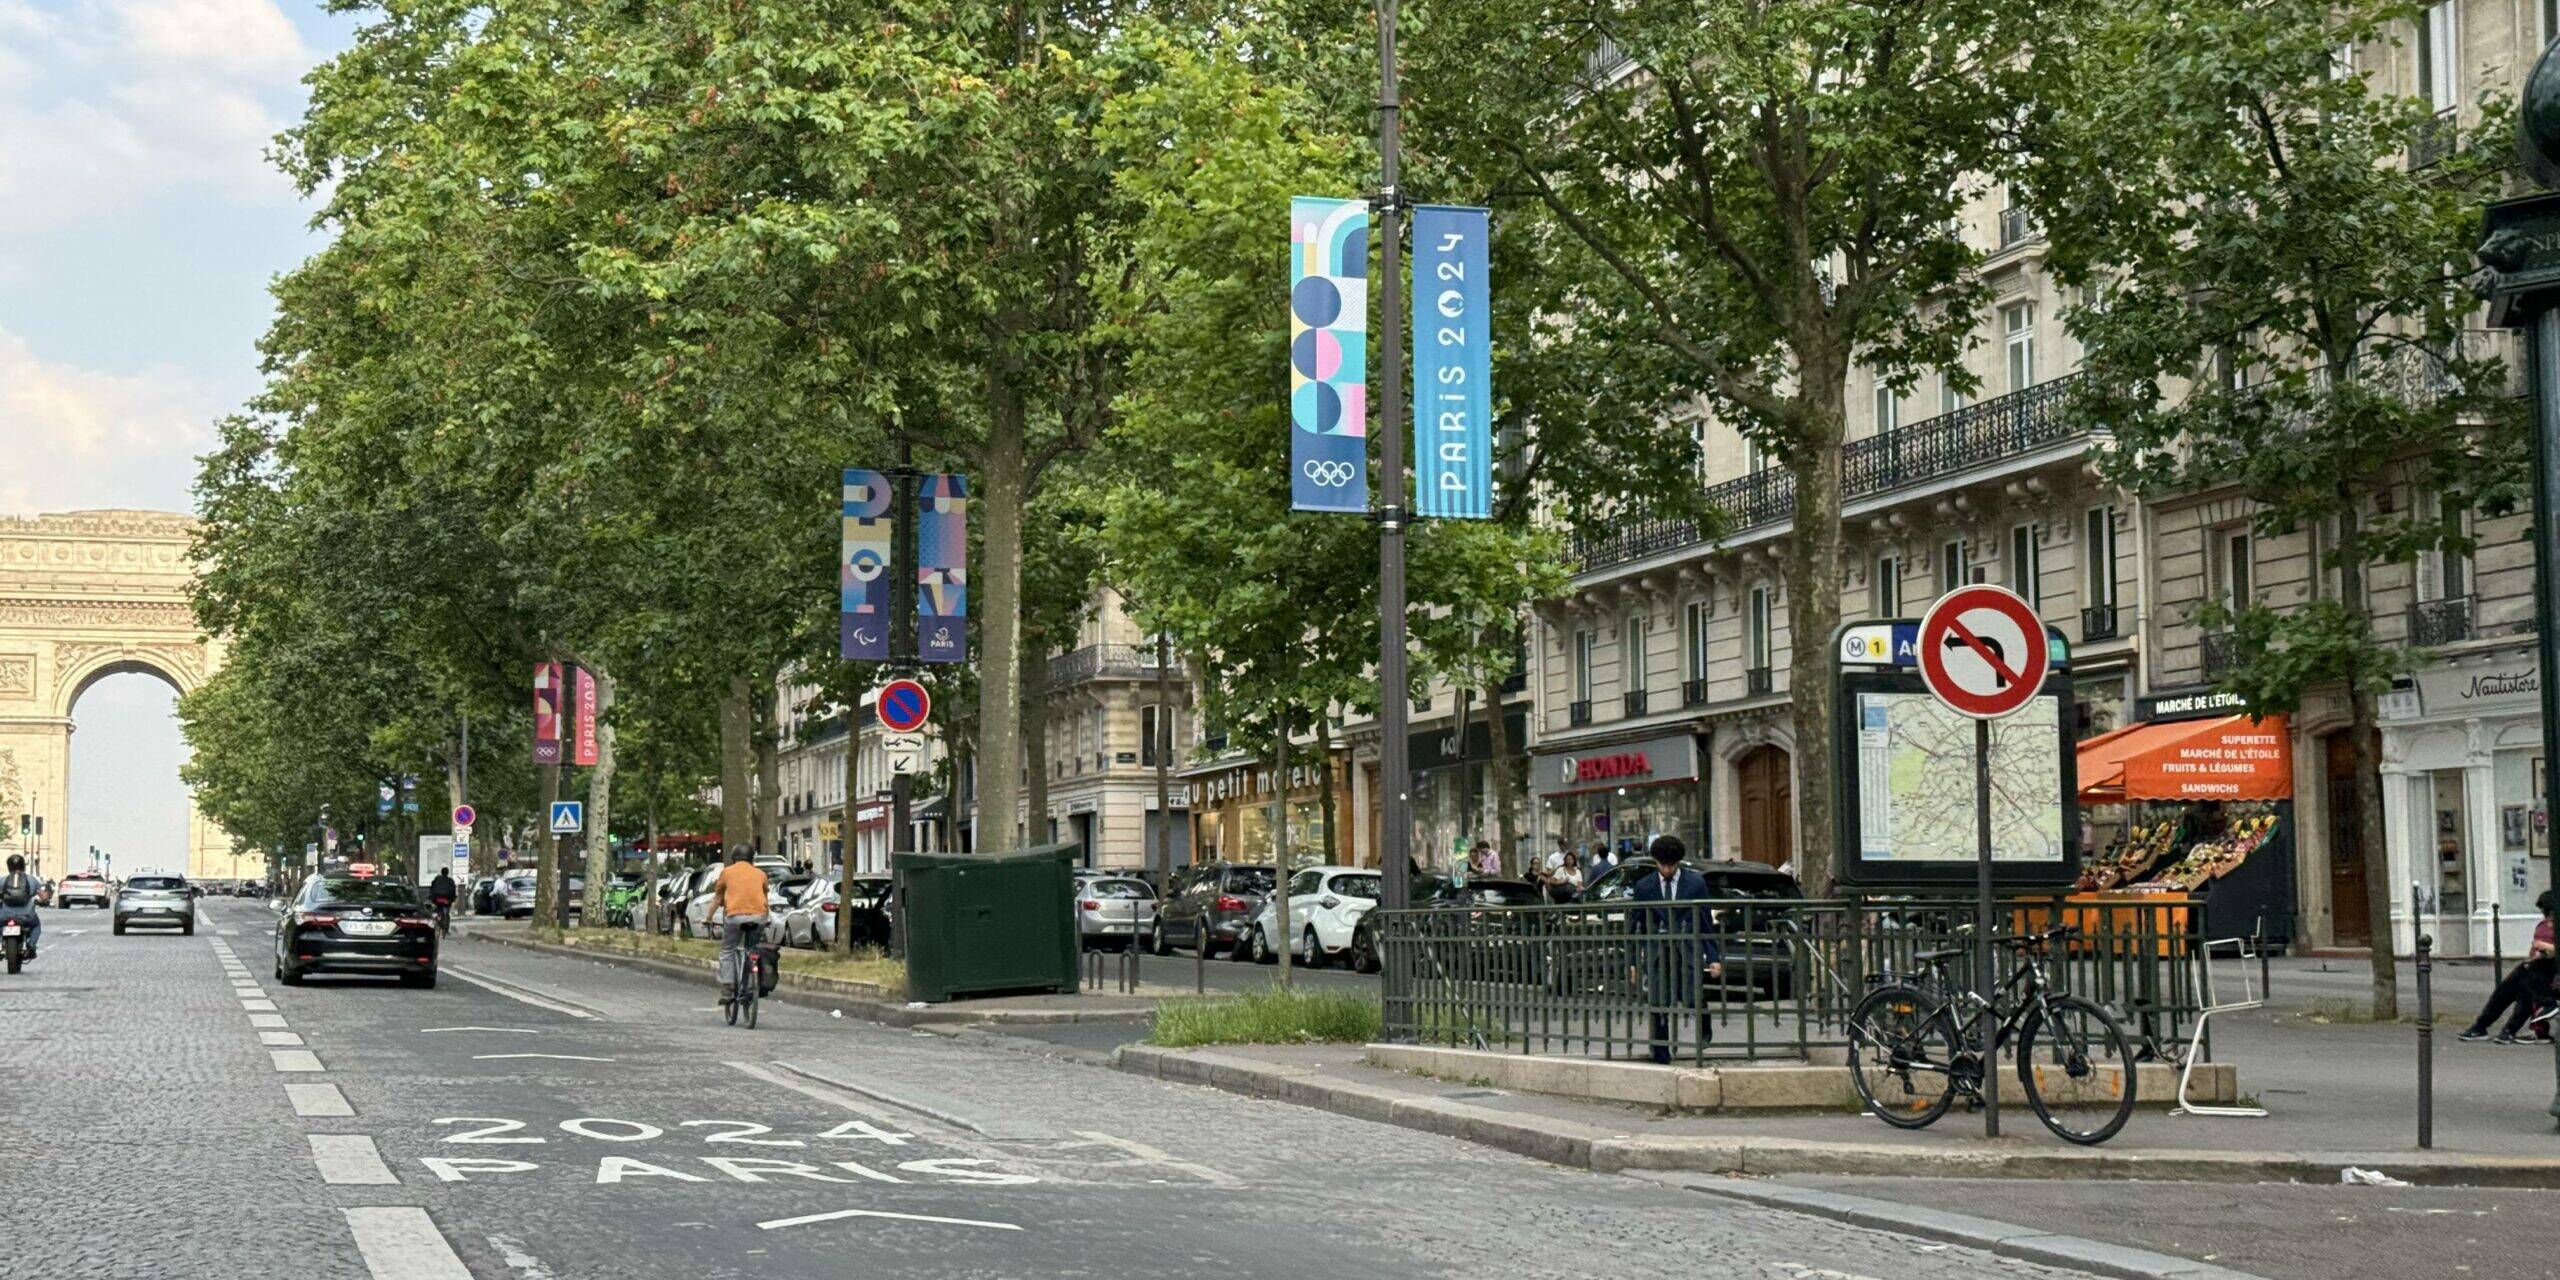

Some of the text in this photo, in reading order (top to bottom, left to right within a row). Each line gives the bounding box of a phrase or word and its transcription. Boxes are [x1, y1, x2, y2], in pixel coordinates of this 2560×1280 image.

[1437, 233, 1465, 346] 2024
[1873, 641, 1880, 653] 1
[2156, 695, 2193, 714] MARCHÉ
[2195, 696, 2207, 710] DE
[2221, 735, 2276, 745] SUPERETTE
[2181, 748, 2280, 759] MARCHÉ DE L'ÉTOILE
[1577, 751, 1653, 780] HONDA
[2163, 762, 2255, 773] FRUITS & LÉGUMES
[1182, 782, 1199, 806] au
[1207, 768, 1248, 810] petit
[2181, 784, 2239, 793] SANDWICHS
[431, 1117, 914, 1147] 2024
[419, 1156, 1041, 1185] PARIS
